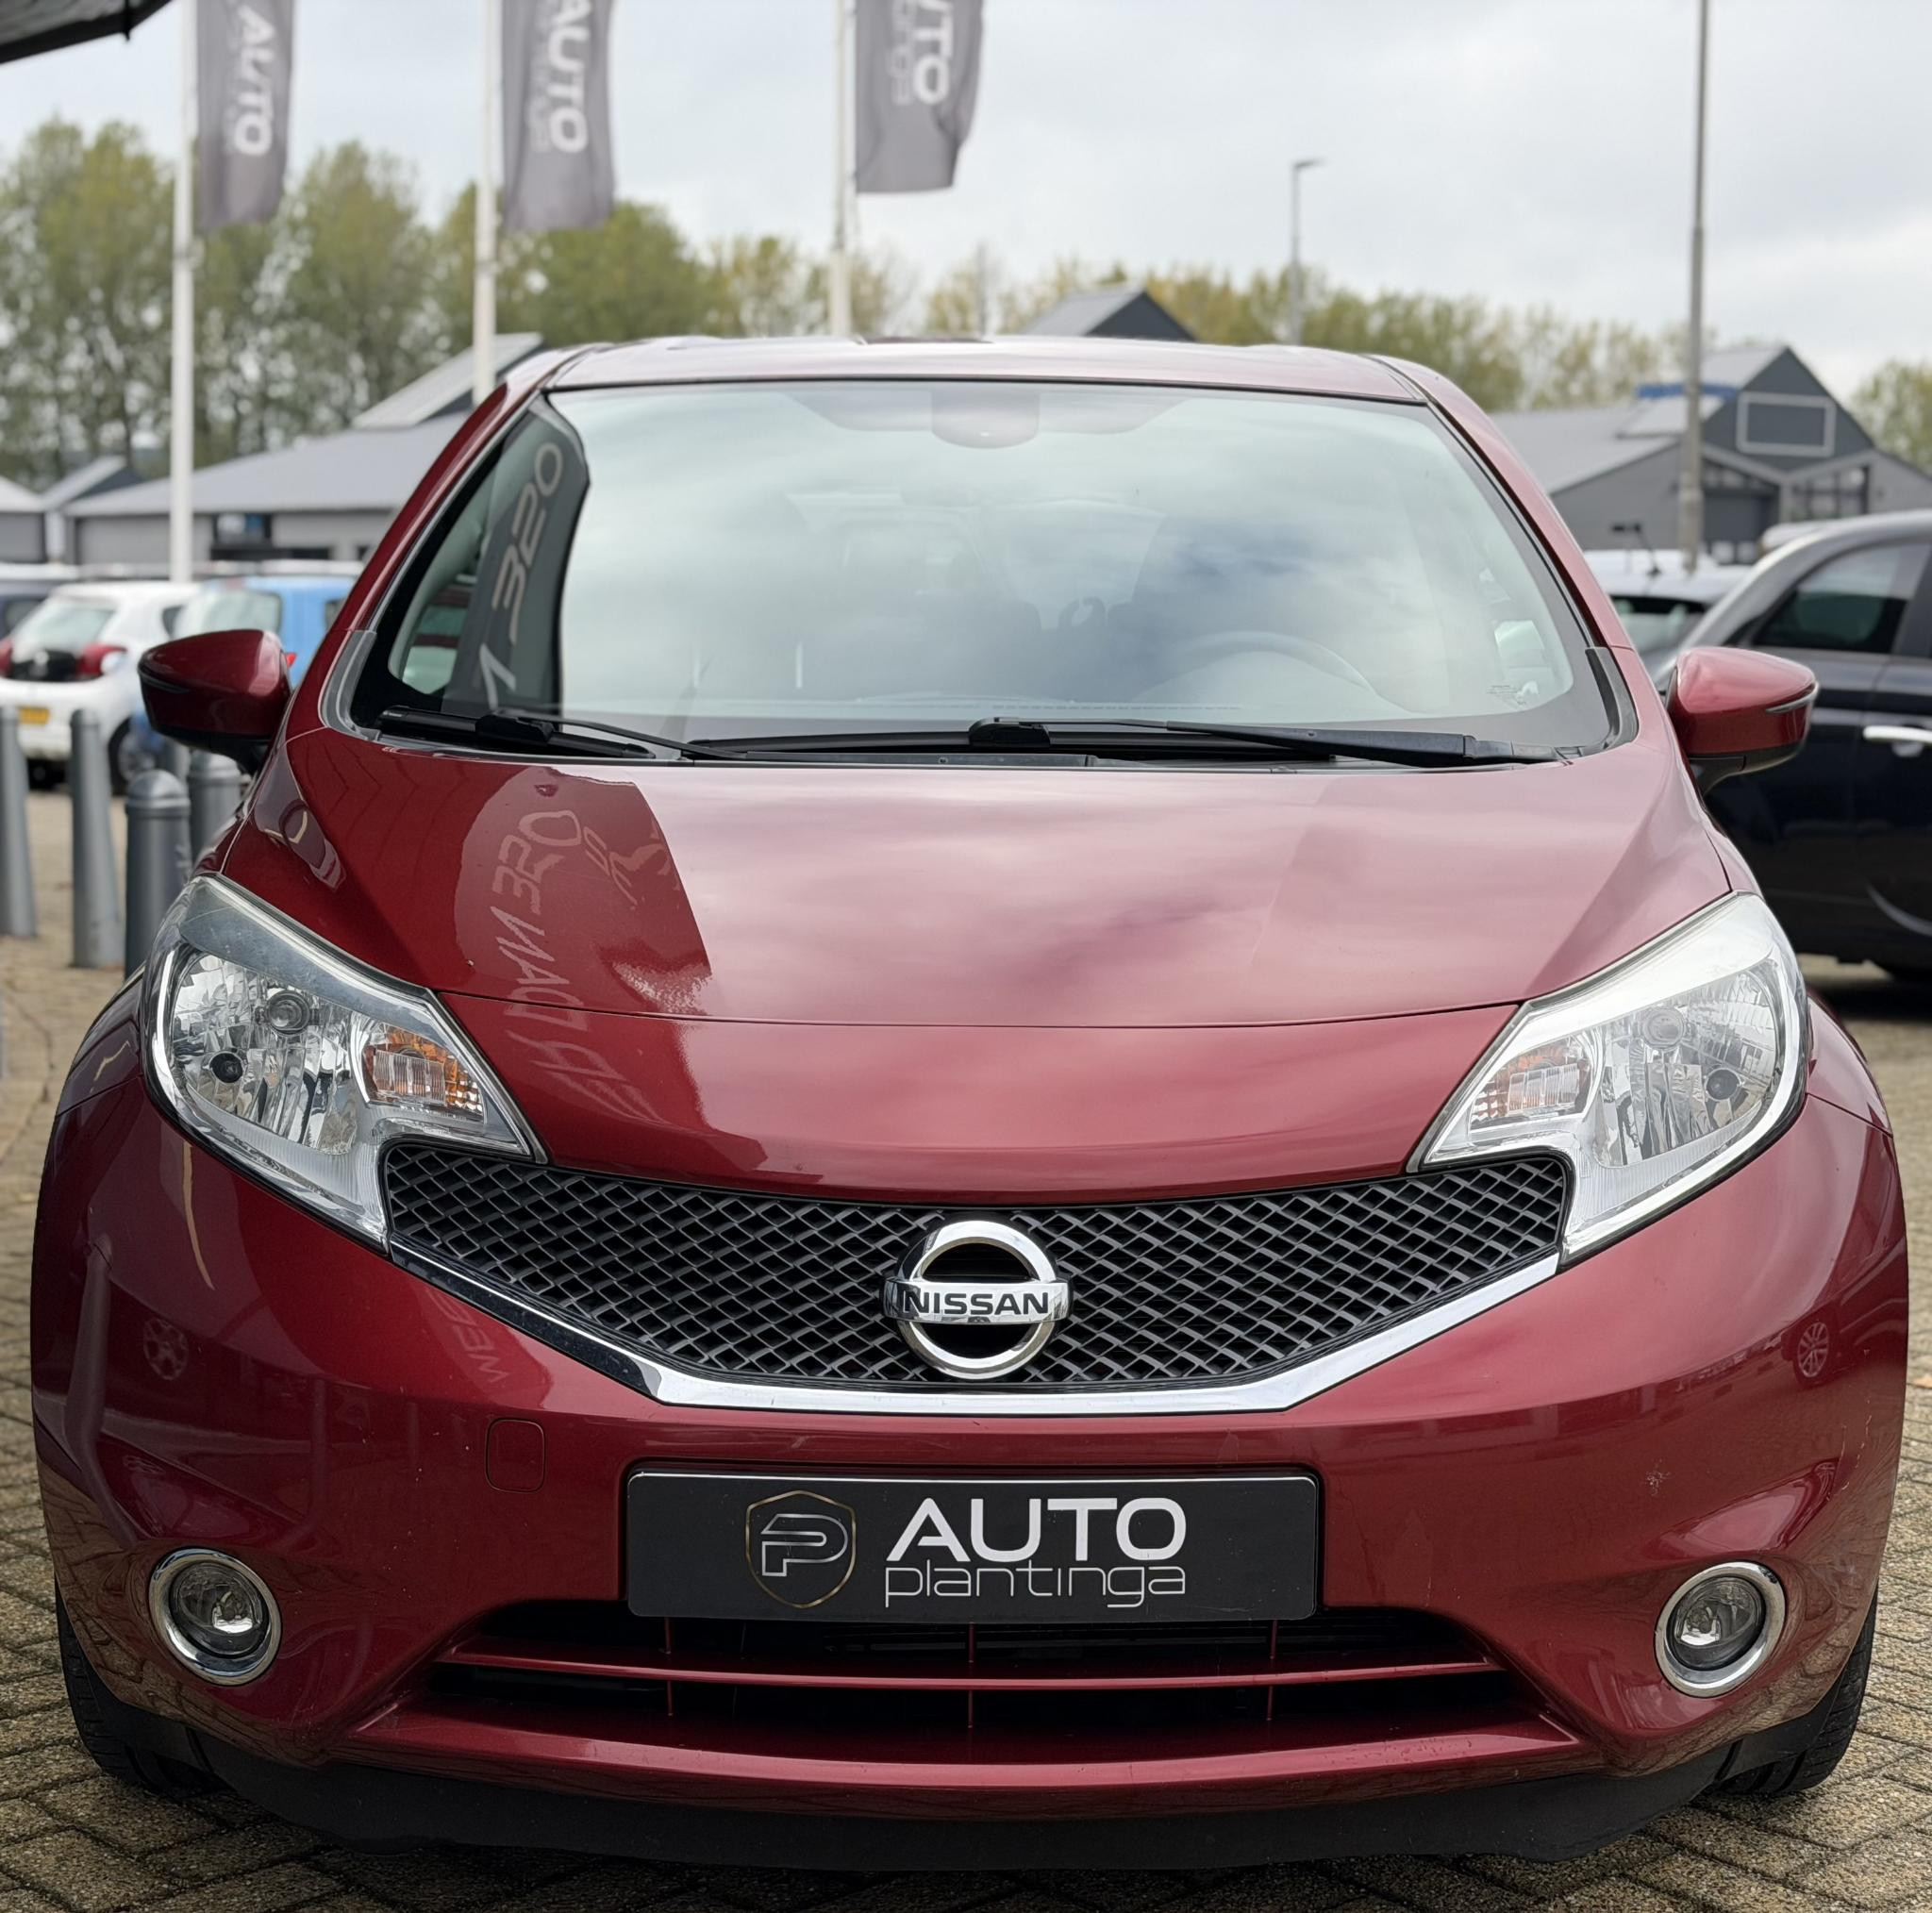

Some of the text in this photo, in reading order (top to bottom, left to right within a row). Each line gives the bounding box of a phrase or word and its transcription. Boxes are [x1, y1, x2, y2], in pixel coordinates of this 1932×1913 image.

[233, 6, 275, 158] AUTO
[547, 0, 590, 154] AUTO
[903, 1291, 1049, 1316] NISSAN
[886, 1498, 1186, 1562] AUTO
[885, 1560, 1186, 1608] plantinga
